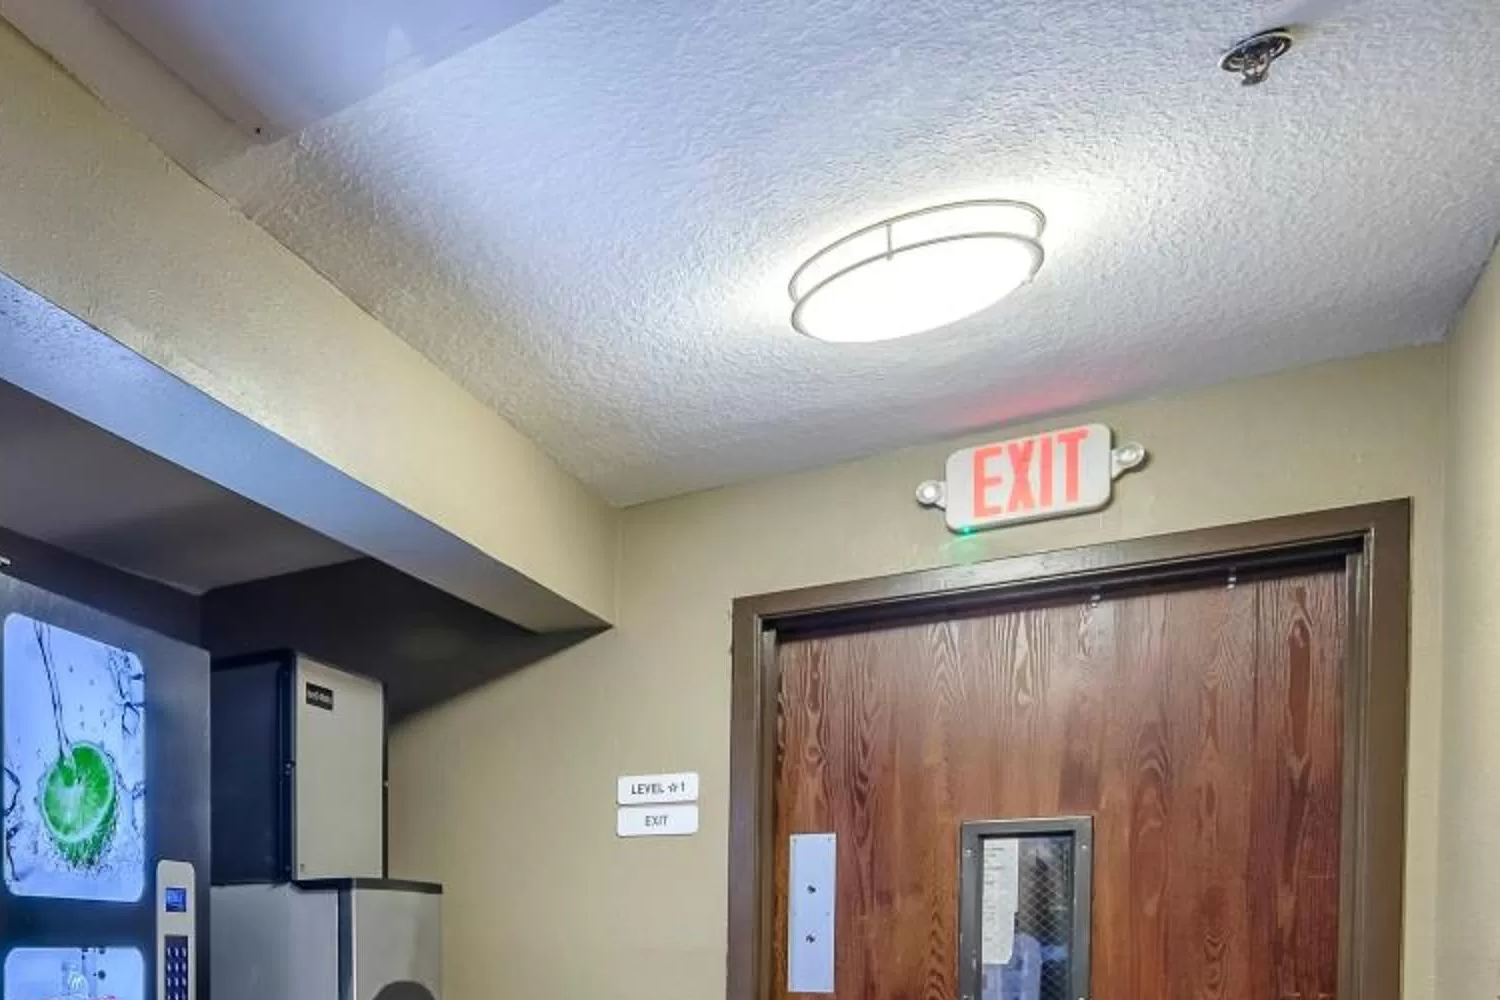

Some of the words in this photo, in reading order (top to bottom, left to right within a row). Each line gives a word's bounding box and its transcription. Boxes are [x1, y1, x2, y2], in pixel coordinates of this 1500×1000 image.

[972, 426, 1090, 519] EXIT
[631, 783, 665, 795] LEVEL
[645, 815, 668, 827] EXIT
